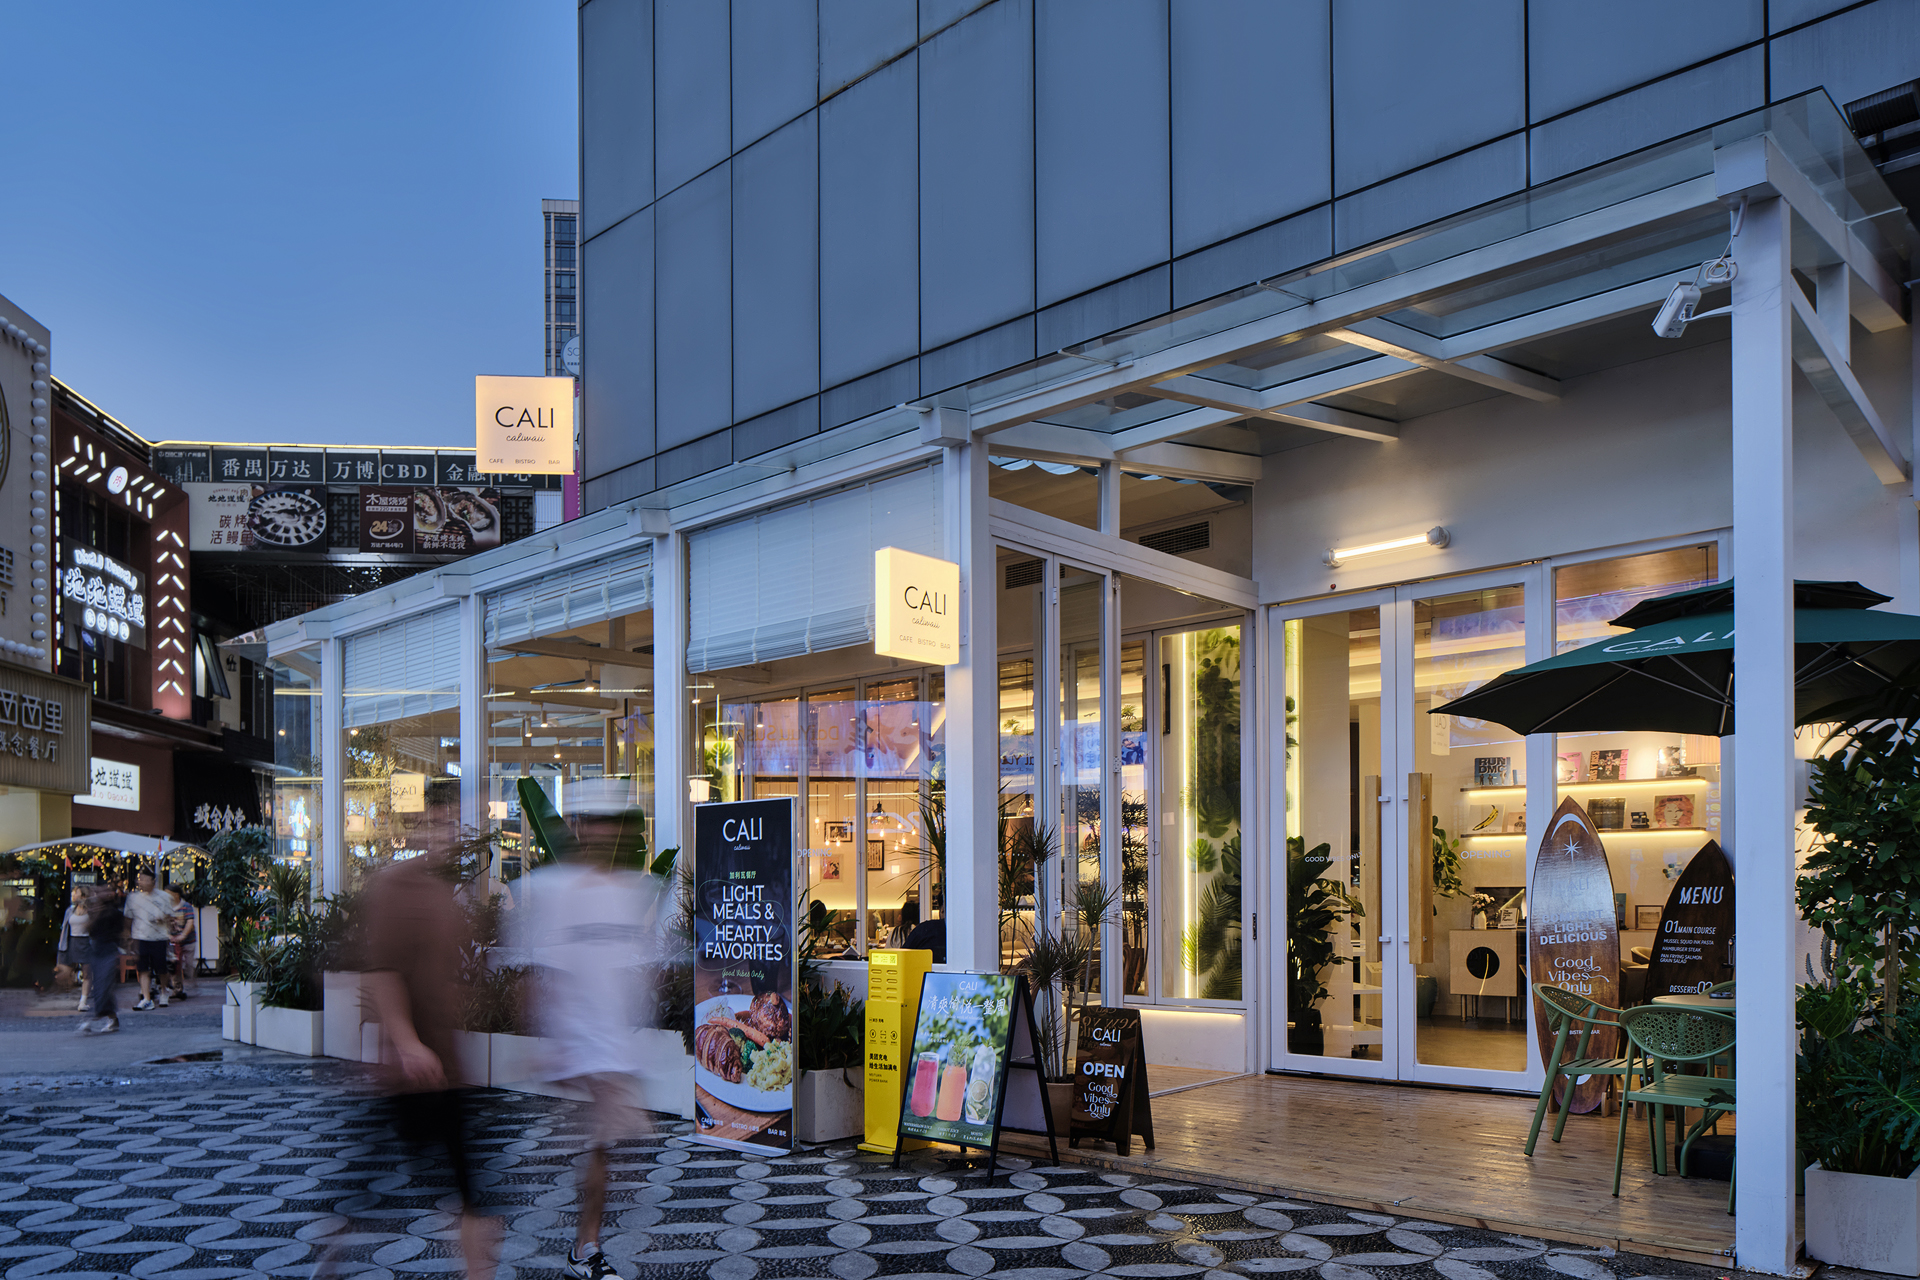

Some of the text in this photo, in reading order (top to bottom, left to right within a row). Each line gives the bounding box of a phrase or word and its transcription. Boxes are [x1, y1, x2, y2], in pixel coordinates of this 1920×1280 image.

[495, 406, 554, 429] CALI
[222, 457, 311, 479] 番禺万达
[333, 460, 427, 480] 万博CBD
[365, 493, 408, 506] 木屋烧烤
[219, 514, 248, 529] 碳烤
[371, 520, 388, 533] 24
[210, 530, 254, 546] 活鳗鱼
[65, 566, 146, 628] 地地道道
[904, 585, 947, 615] CALI
[899, 634, 951, 650] CAFE BISTRO BAR
[1479, 757, 1506, 766] RUN
[1479, 765, 1506, 774] DMC
[91, 766, 133, 790] 地道道
[722, 817, 763, 842] CALI
[1345, 851, 1363, 861] ONLY
[1460, 849, 1512, 860] OPENING
[722, 884, 765, 902] LIGHT
[1679, 886, 1724, 905] MENU
[713, 903, 775, 920] MEALS &
[1542, 909, 1604, 924] COMFORT
[715, 924, 774, 942] HEARTY
[1554, 921, 1592, 934] LIGHT
[1693, 926, 1717, 935] COURSE
[1540, 930, 1608, 945] DELICIOUS
[705, 942, 783, 961] FAVORITES
[1554, 956, 1602, 972] Good
[721, 968, 736, 979] Good
[751, 970, 765, 981] Only
[1548, 970, 1610, 983] Vibes
[959, 980, 978, 991] CALI
[1558, 981, 1592, 996] Only
[1669, 985, 1698, 994] DESSERTS
[926, 995, 1006, 1015] 清爽愉悦一整周
[1092, 1027, 1122, 1043] CALI
[869, 1053, 888, 1061] 美团充电
[869, 1062, 898, 1071] 给生活加满电
[1082, 1061, 1125, 1079] OPEN
[1088, 1081, 1118, 1098] Good
[1083, 1092, 1119, 1105] Vibes
[1084, 1102, 1111, 1119] Only
